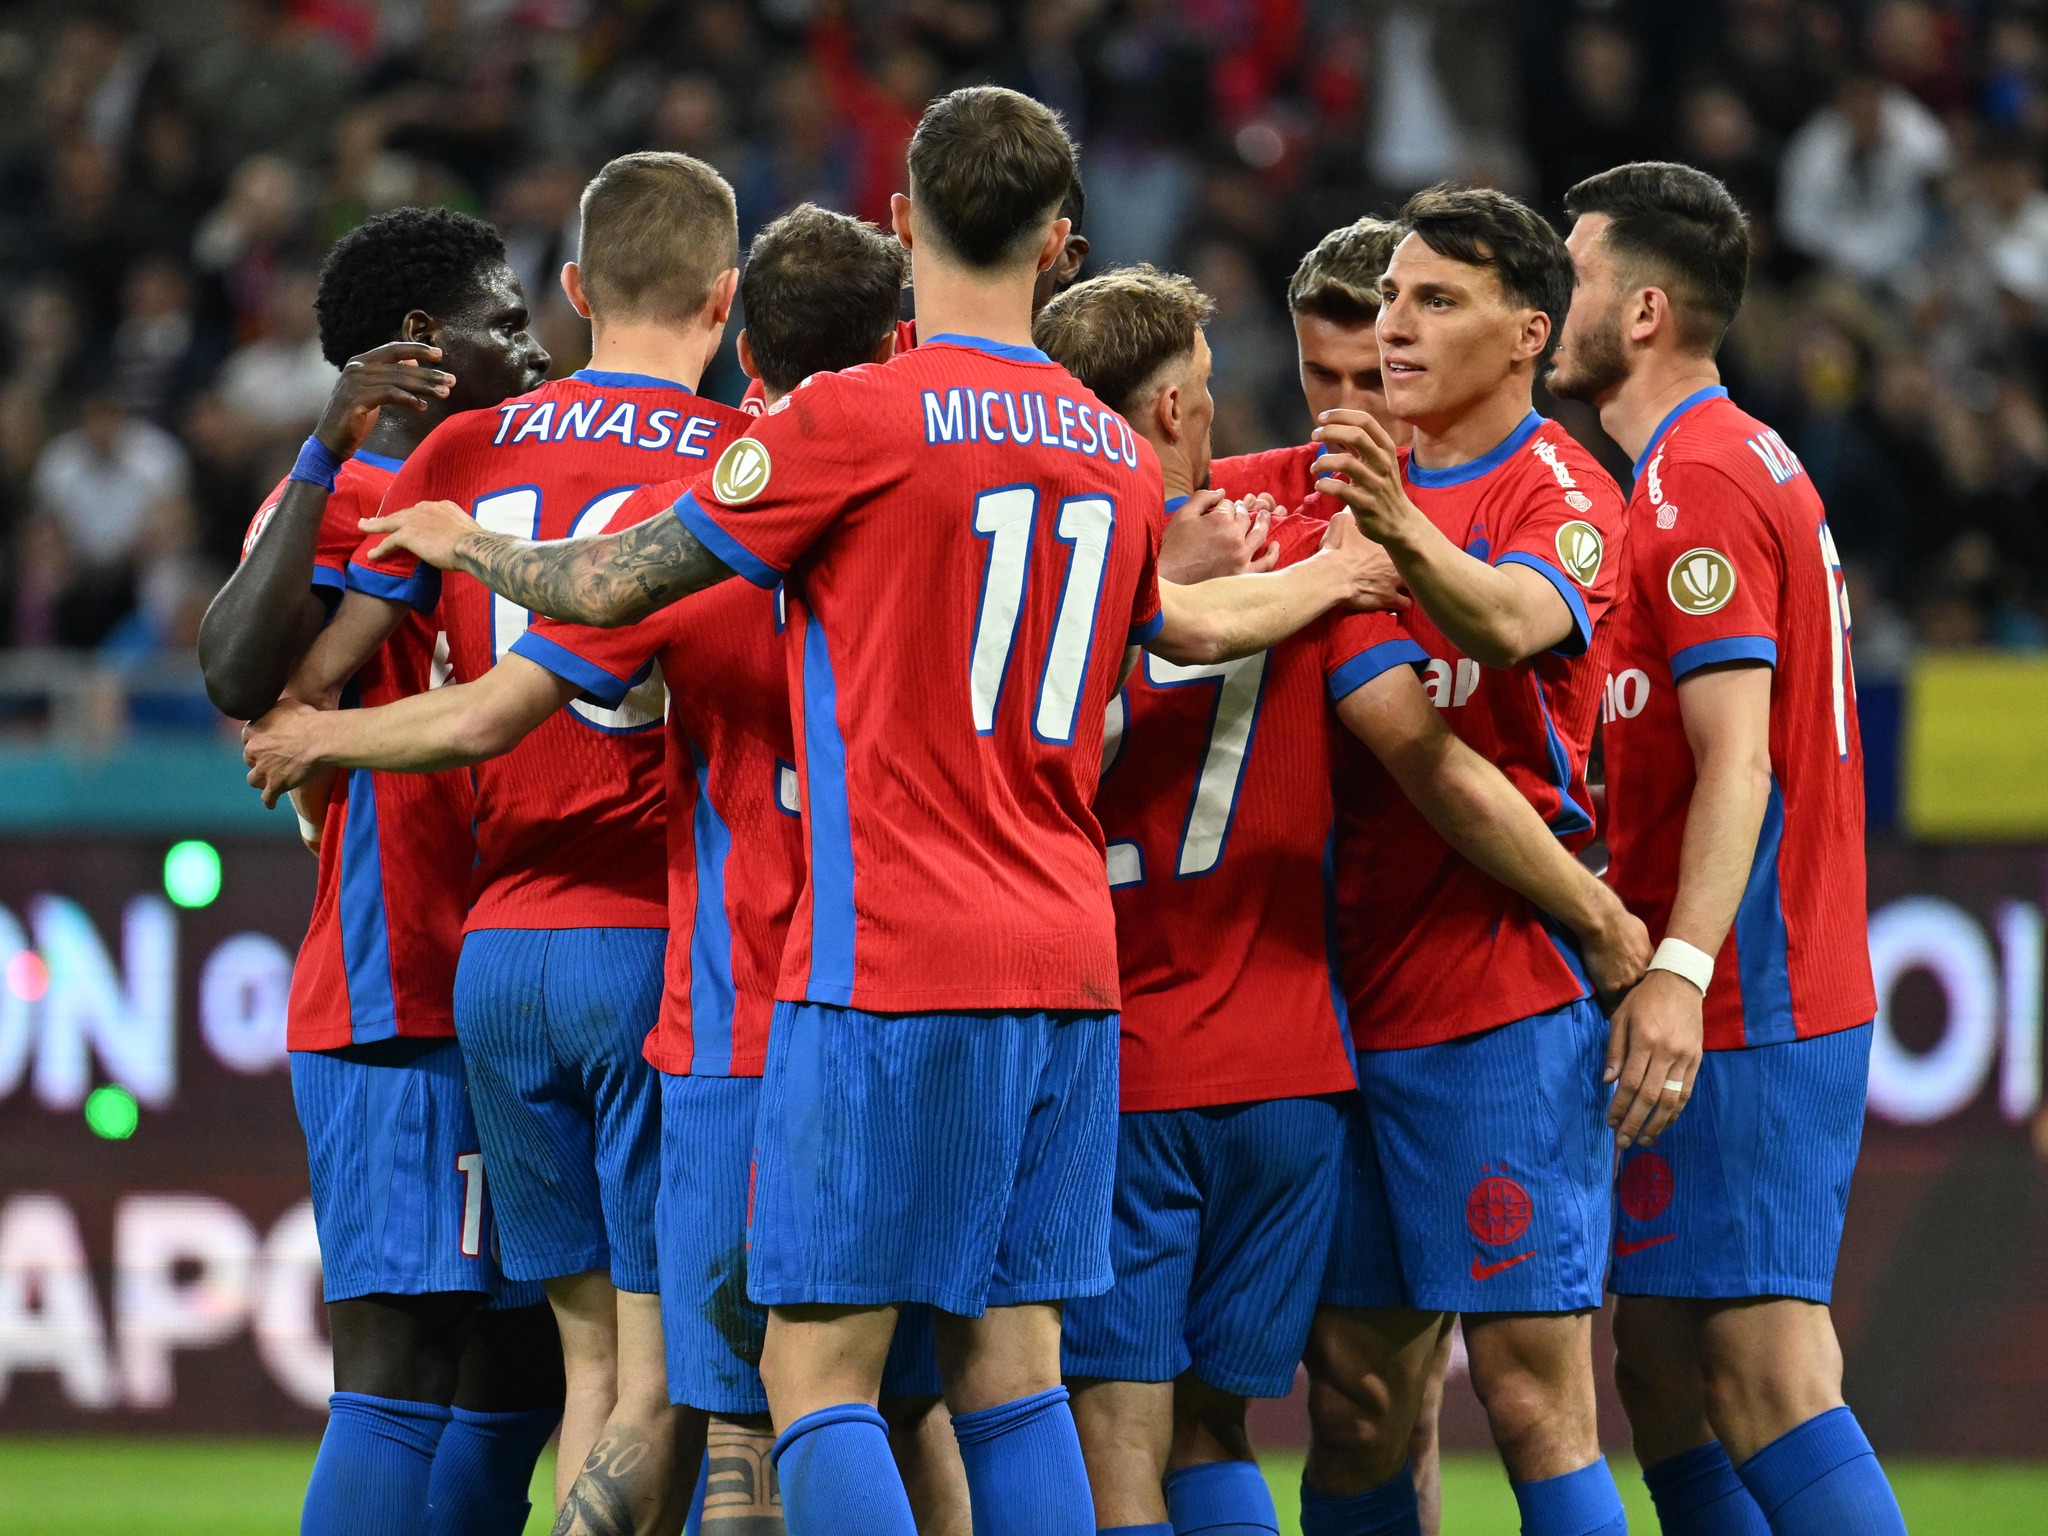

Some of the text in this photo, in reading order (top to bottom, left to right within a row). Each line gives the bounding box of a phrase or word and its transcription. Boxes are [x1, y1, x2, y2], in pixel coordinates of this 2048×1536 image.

[492, 398, 720, 460] TANASE
[921, 387, 1138, 471] MICULESCU
[969, 482, 1116, 747] 11
